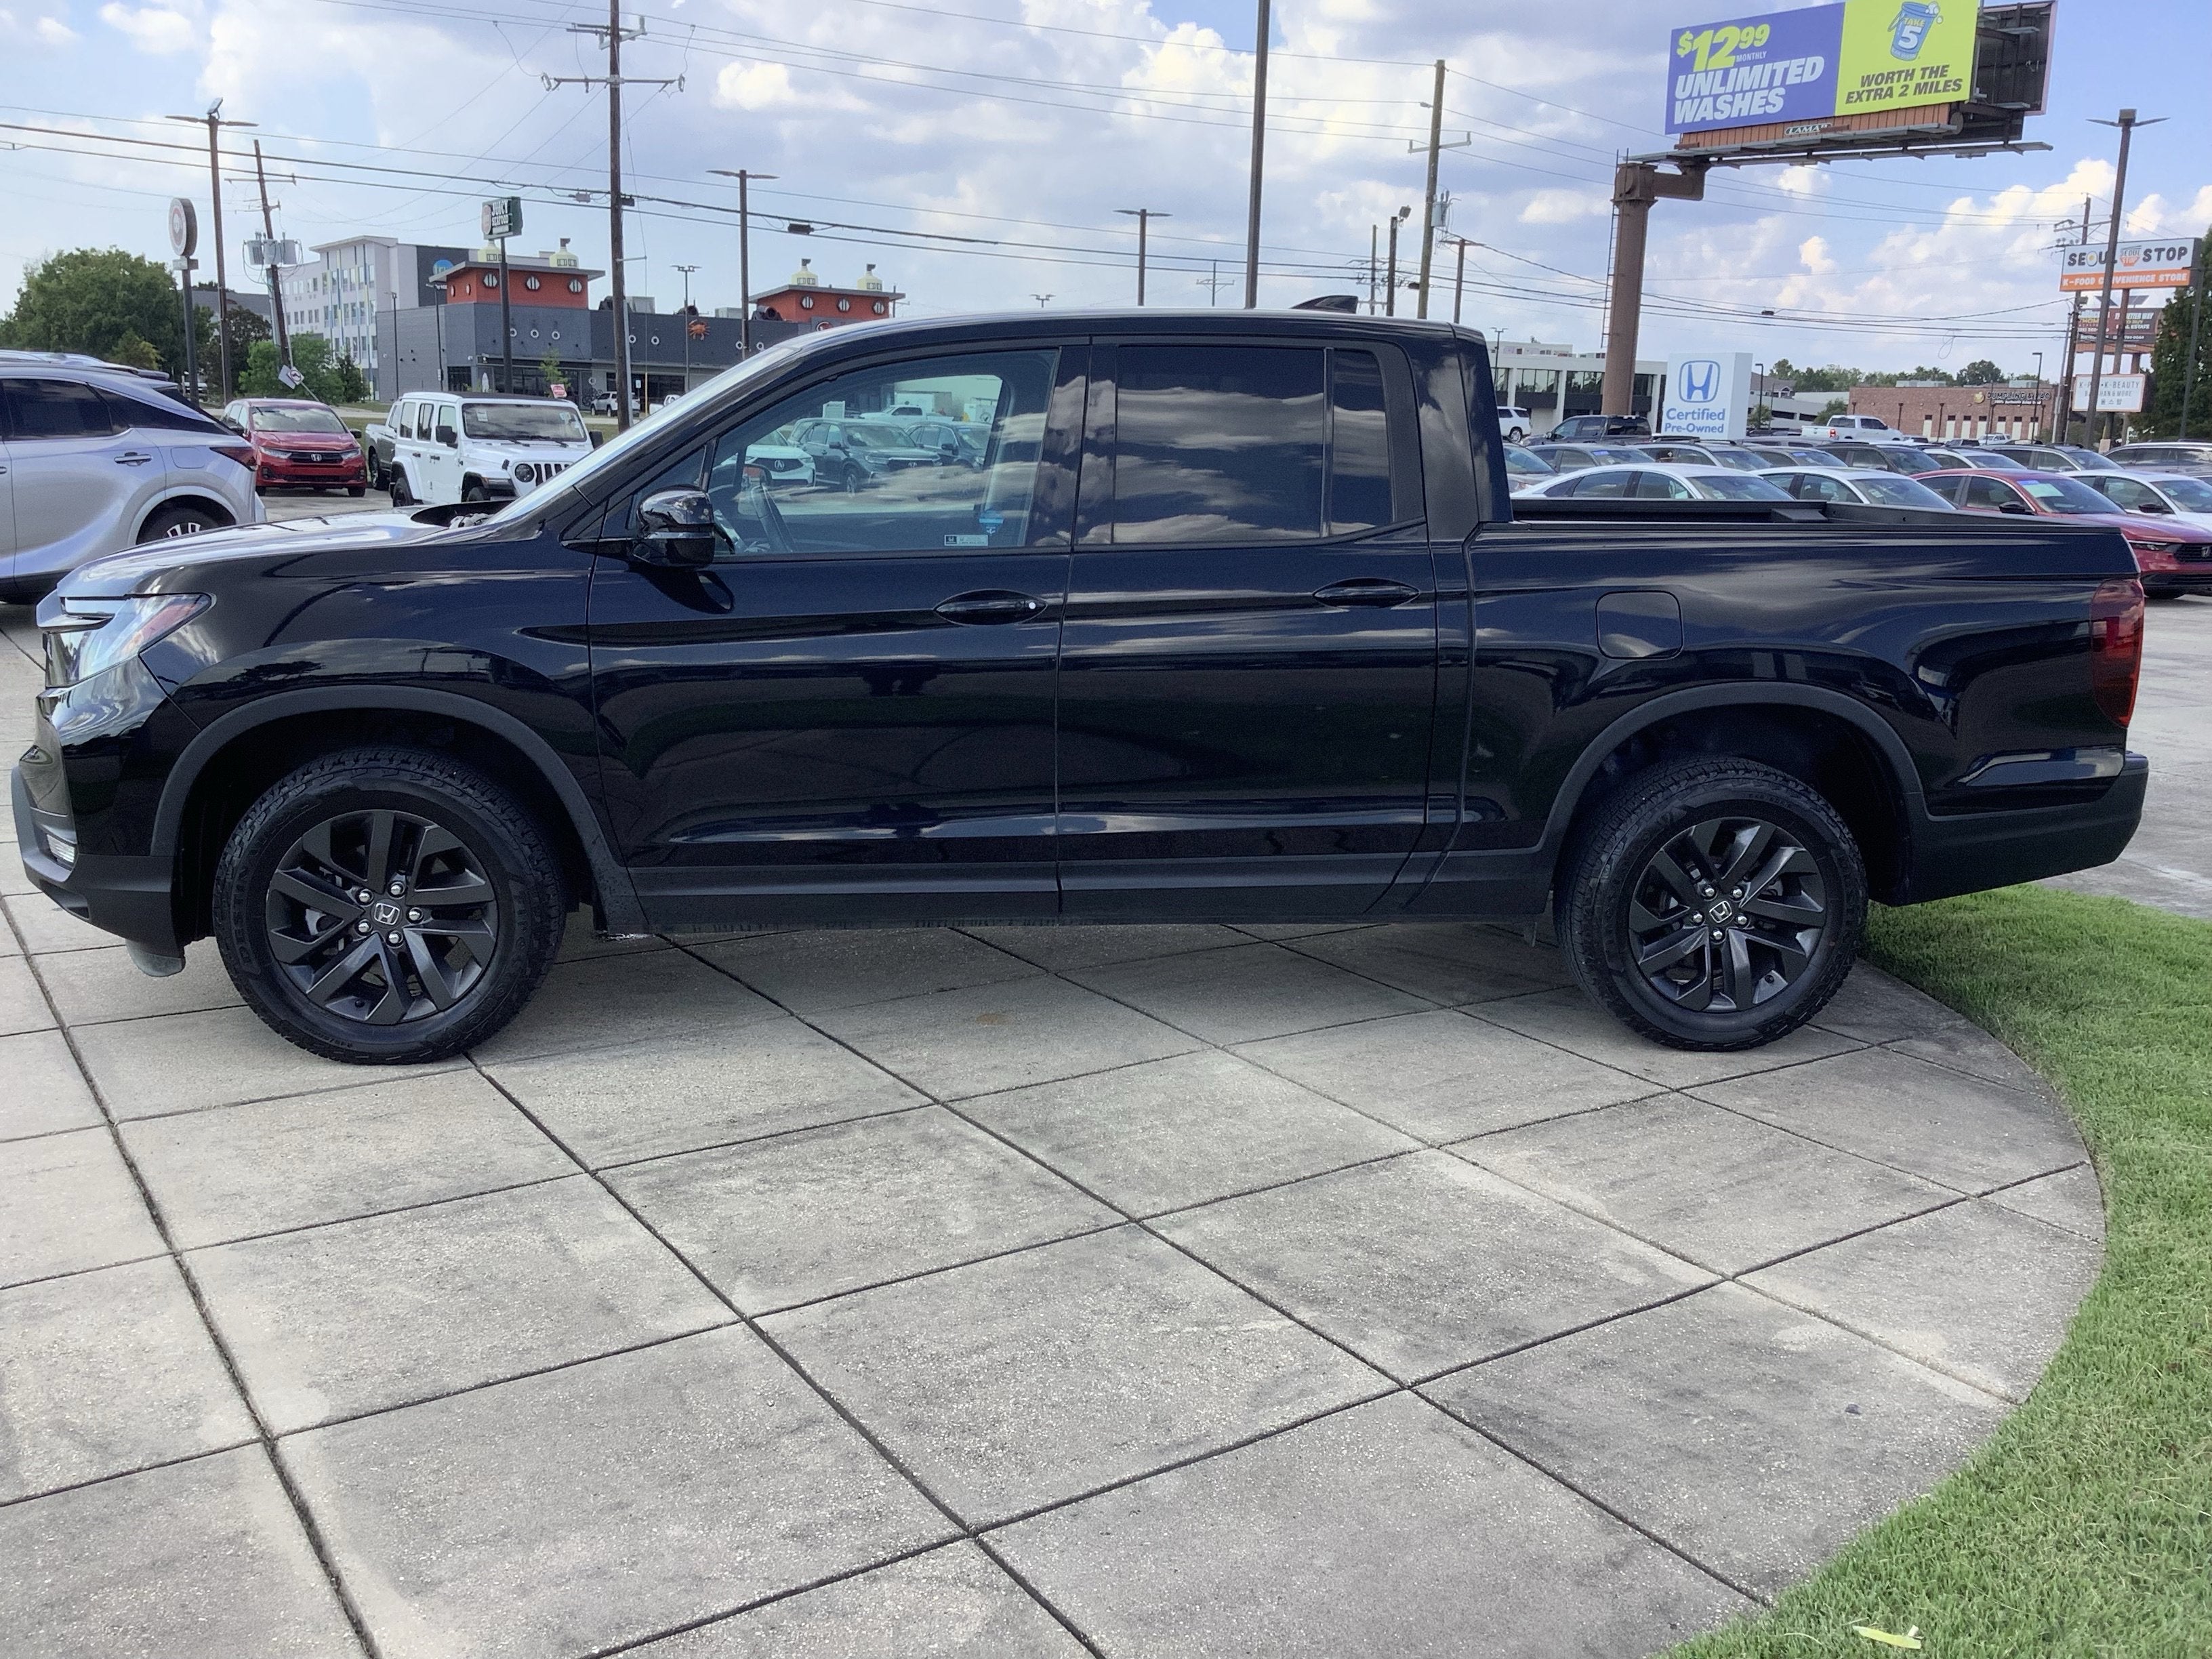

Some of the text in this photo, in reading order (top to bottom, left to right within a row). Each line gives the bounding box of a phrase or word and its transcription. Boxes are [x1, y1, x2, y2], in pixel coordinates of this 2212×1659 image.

[1904, 18, 1925, 27] TAKE
[1898, 26, 1922, 49] 5
[1736, 51, 1767, 62] MONTHLY
[1675, 56, 1824, 100] UNLIMITED
[1860, 64, 1950, 87] WORTH THE
[1845, 79, 1963, 104] EXTRA 2 MILES
[1674, 87, 1786, 125] WASHES
[492, 200, 508, 216] JUICY
[2068, 247, 2188, 267] SEOU STOP
[2063, 273, 2188, 286] K-FOOD CVENIENCE STORE
[1666, 408, 1725, 421] Certified
[1664, 423, 1724, 433] Pre-Owned
